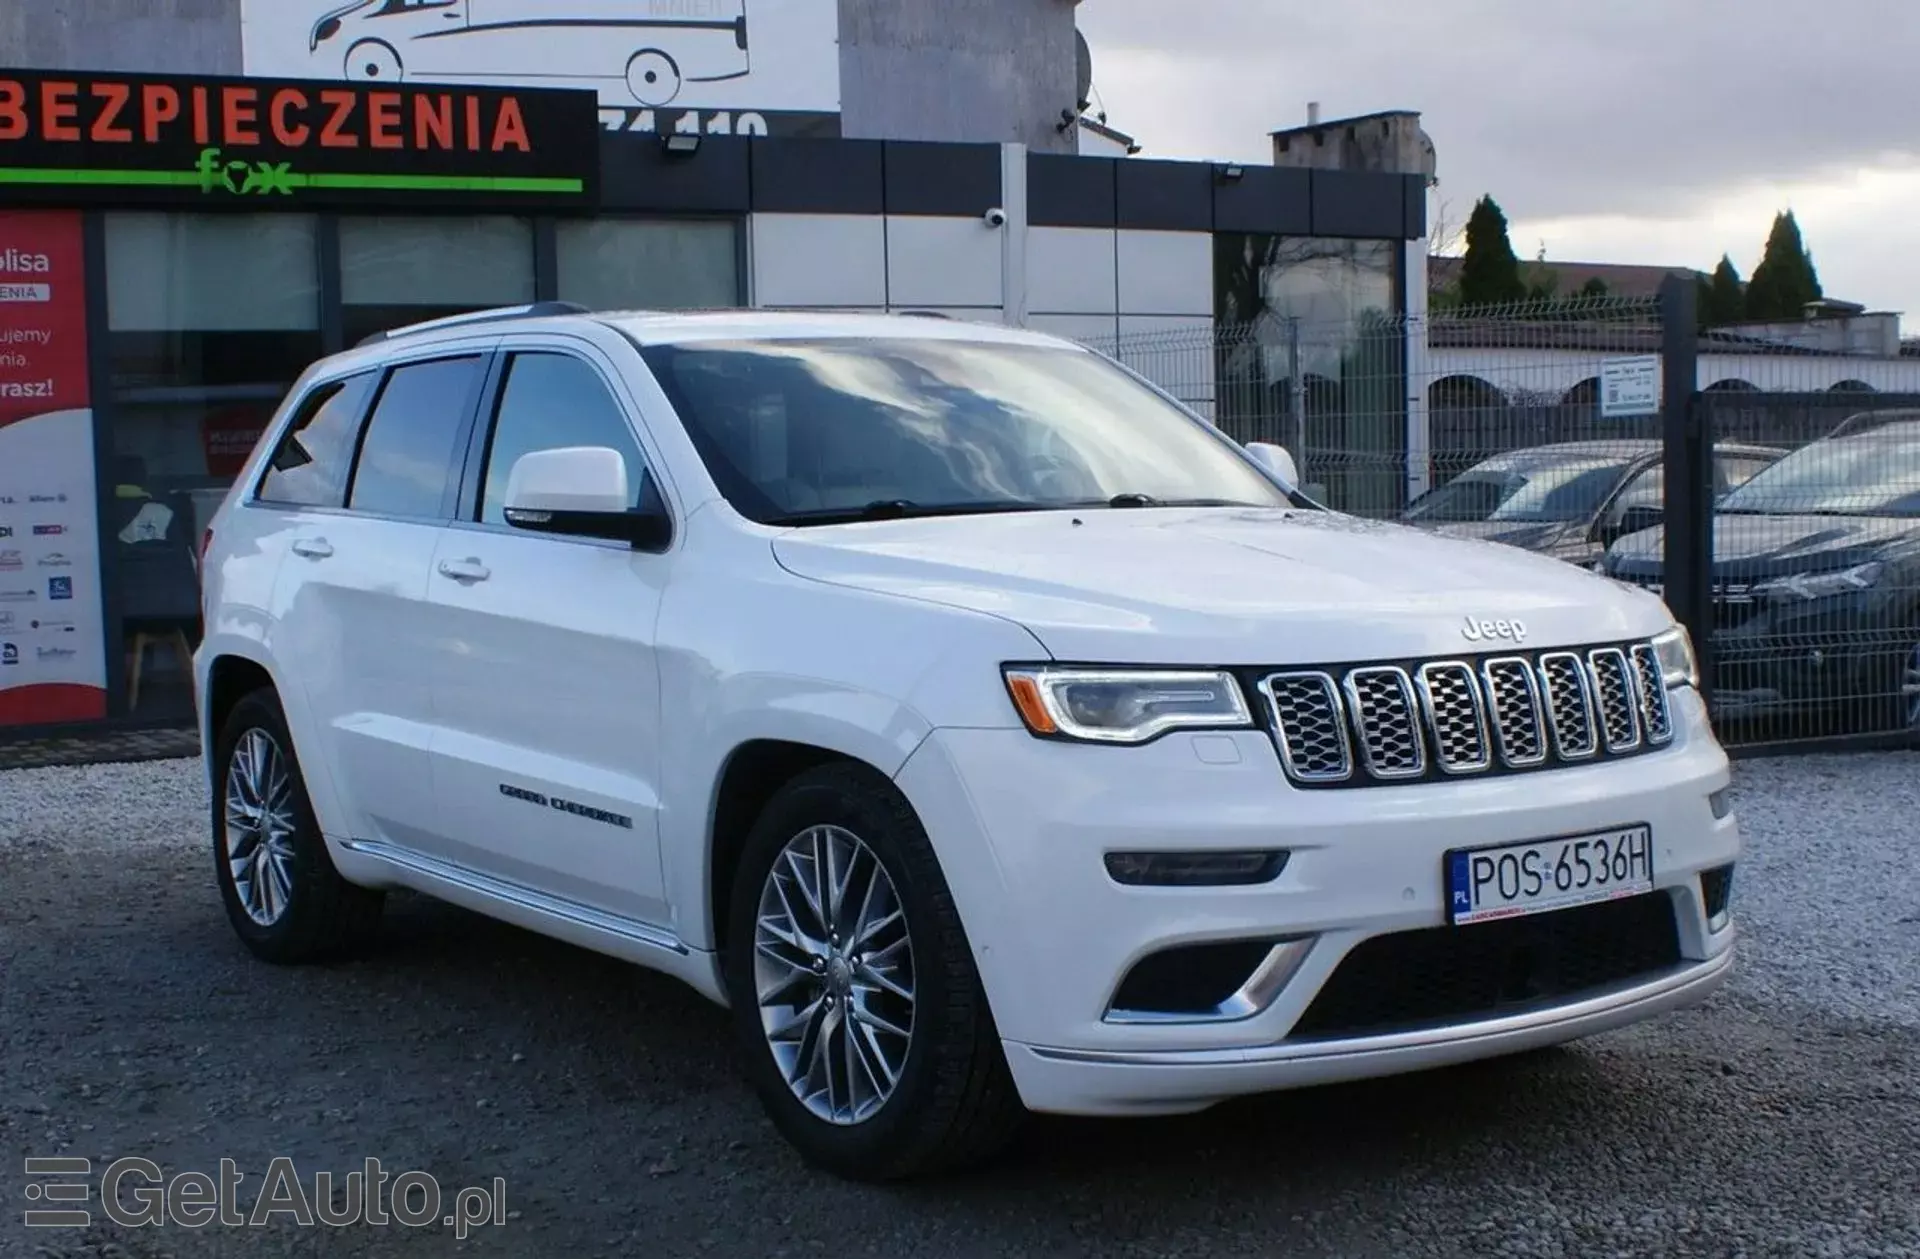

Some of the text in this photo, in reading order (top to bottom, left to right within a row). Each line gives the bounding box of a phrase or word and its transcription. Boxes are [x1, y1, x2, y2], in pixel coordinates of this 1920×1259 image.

[0, 80, 531, 152] BEZPIECZENIA
[1461, 615, 1527, 644] Jeep
[1472, 849, 1543, 905] POS
[1554, 831, 1647, 891] 6536H
[1454, 890, 1469, 904] PL
